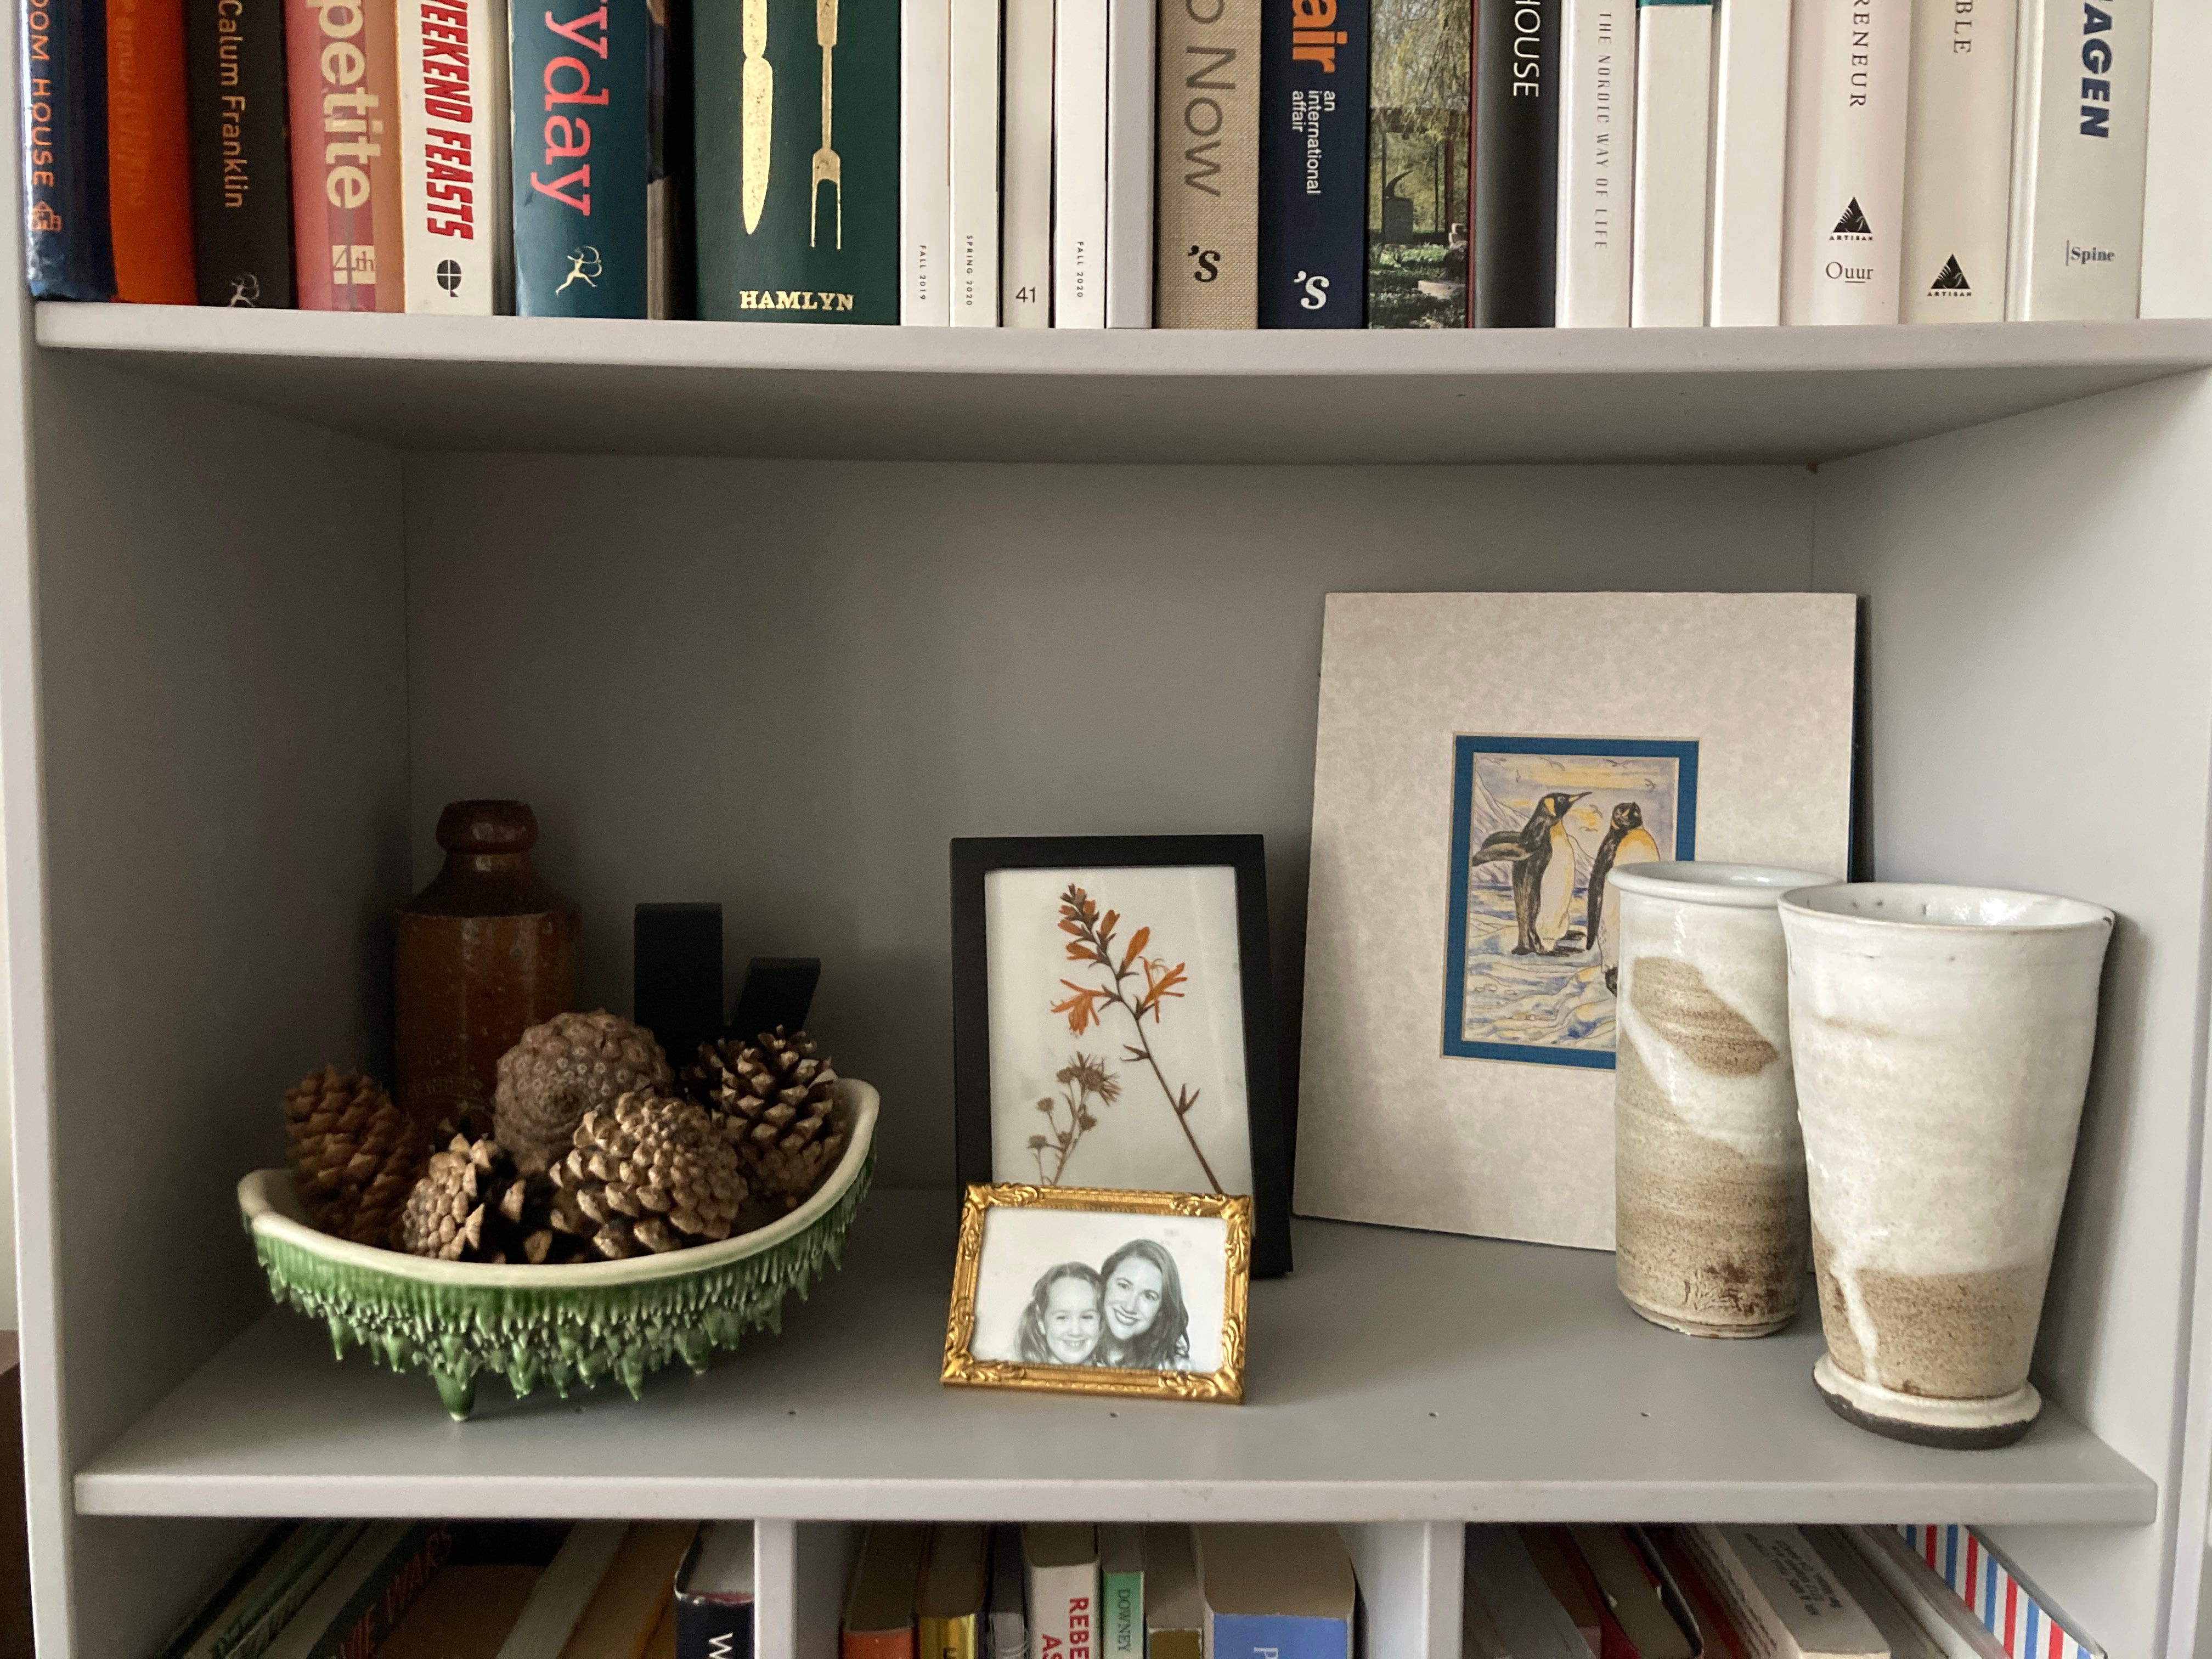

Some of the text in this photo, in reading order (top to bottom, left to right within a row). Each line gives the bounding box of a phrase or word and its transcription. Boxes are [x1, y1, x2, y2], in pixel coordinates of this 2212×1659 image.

[1513, 0, 1541, 97] OUSE
[2080, 0, 2113, 138] AGEN
[31, 78, 54, 188] HOUSE
[218, 0, 249, 207] Calum Franklin
[531, 0, 609, 216] yday
[1292, 91, 1306, 132] affair
[1306, 91, 1323, 195] international
[1324, 91, 1335, 111] an
[1595, 13, 1612, 249] THE NORDIC WAY OF LIFE
[425, 128, 473, 240] FEASTS
[740, 290, 854, 311] HAMLYN
[1015, 286, 1036, 303] 41
[1825, 262, 1874, 280] Ouur
[1069, 1597, 1090, 1659] REBE
[1118, 1589, 1131, 1652] DOWNEY
